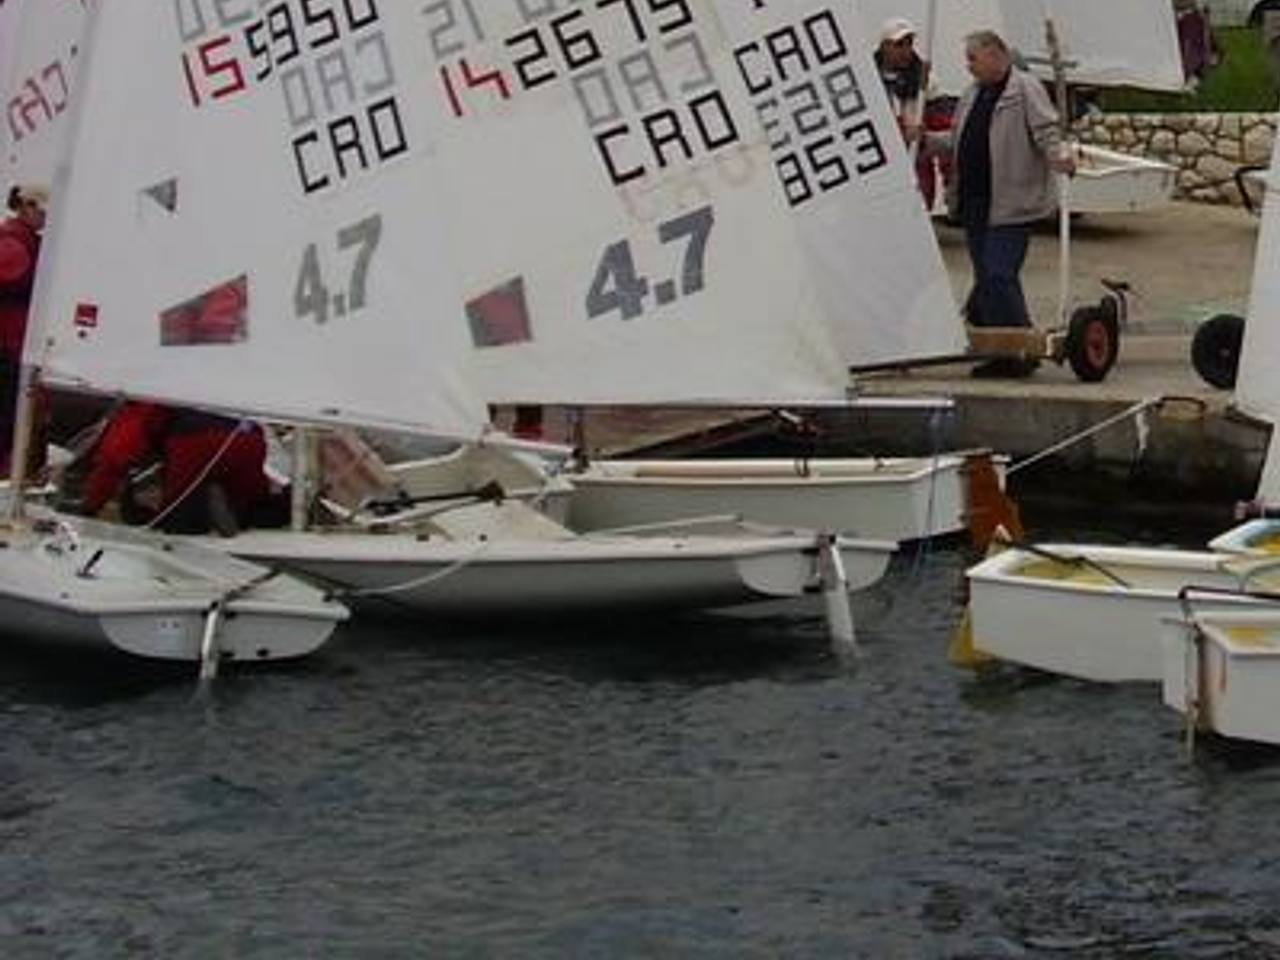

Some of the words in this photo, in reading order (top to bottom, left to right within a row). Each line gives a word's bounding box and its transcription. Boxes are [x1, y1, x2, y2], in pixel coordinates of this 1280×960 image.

[776, 119, 887, 207] 853
[294, 214, 382, 325] 4.7
[585, 205, 714, 321] 4.7
